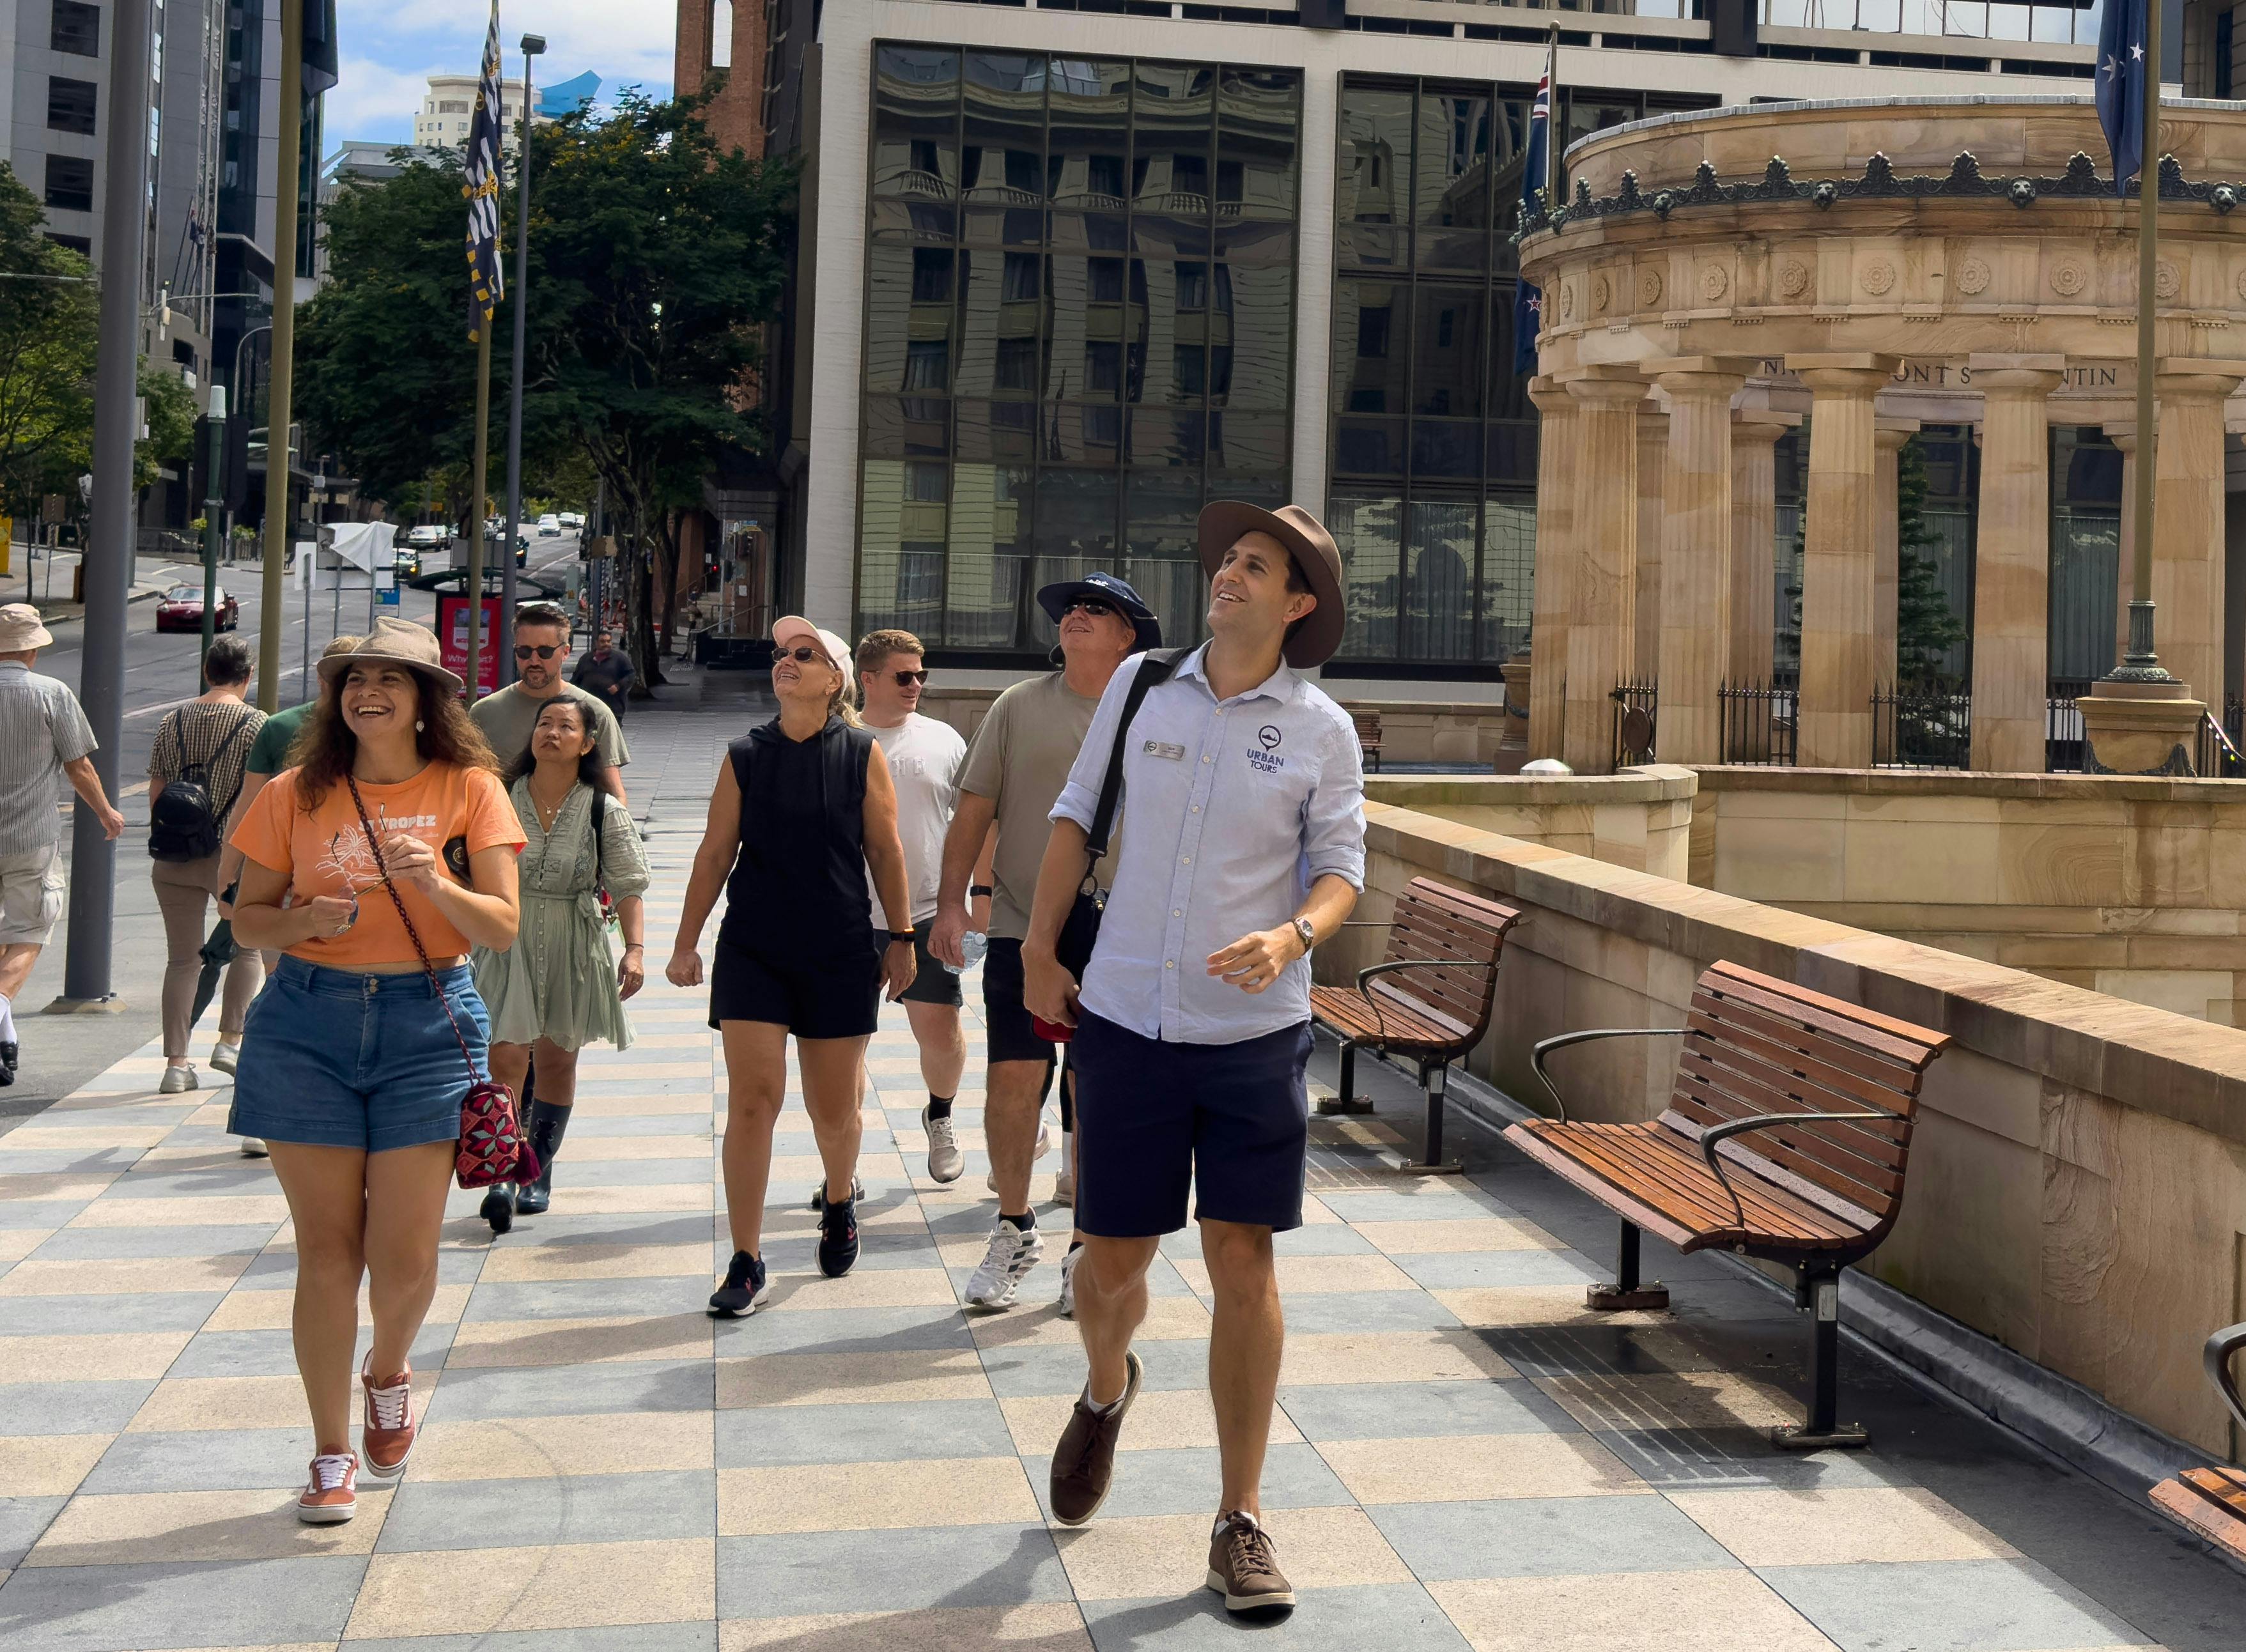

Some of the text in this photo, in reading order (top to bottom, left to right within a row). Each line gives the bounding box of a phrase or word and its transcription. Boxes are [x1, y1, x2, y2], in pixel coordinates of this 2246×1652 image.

[1893, 362, 1953, 383] ONT
[1960, 366, 1971, 384] S
[1246, 748, 1284, 768] URBAN
[1250, 759, 1278, 774] TOURS
[378, 814, 437, 831] TROPEZ
